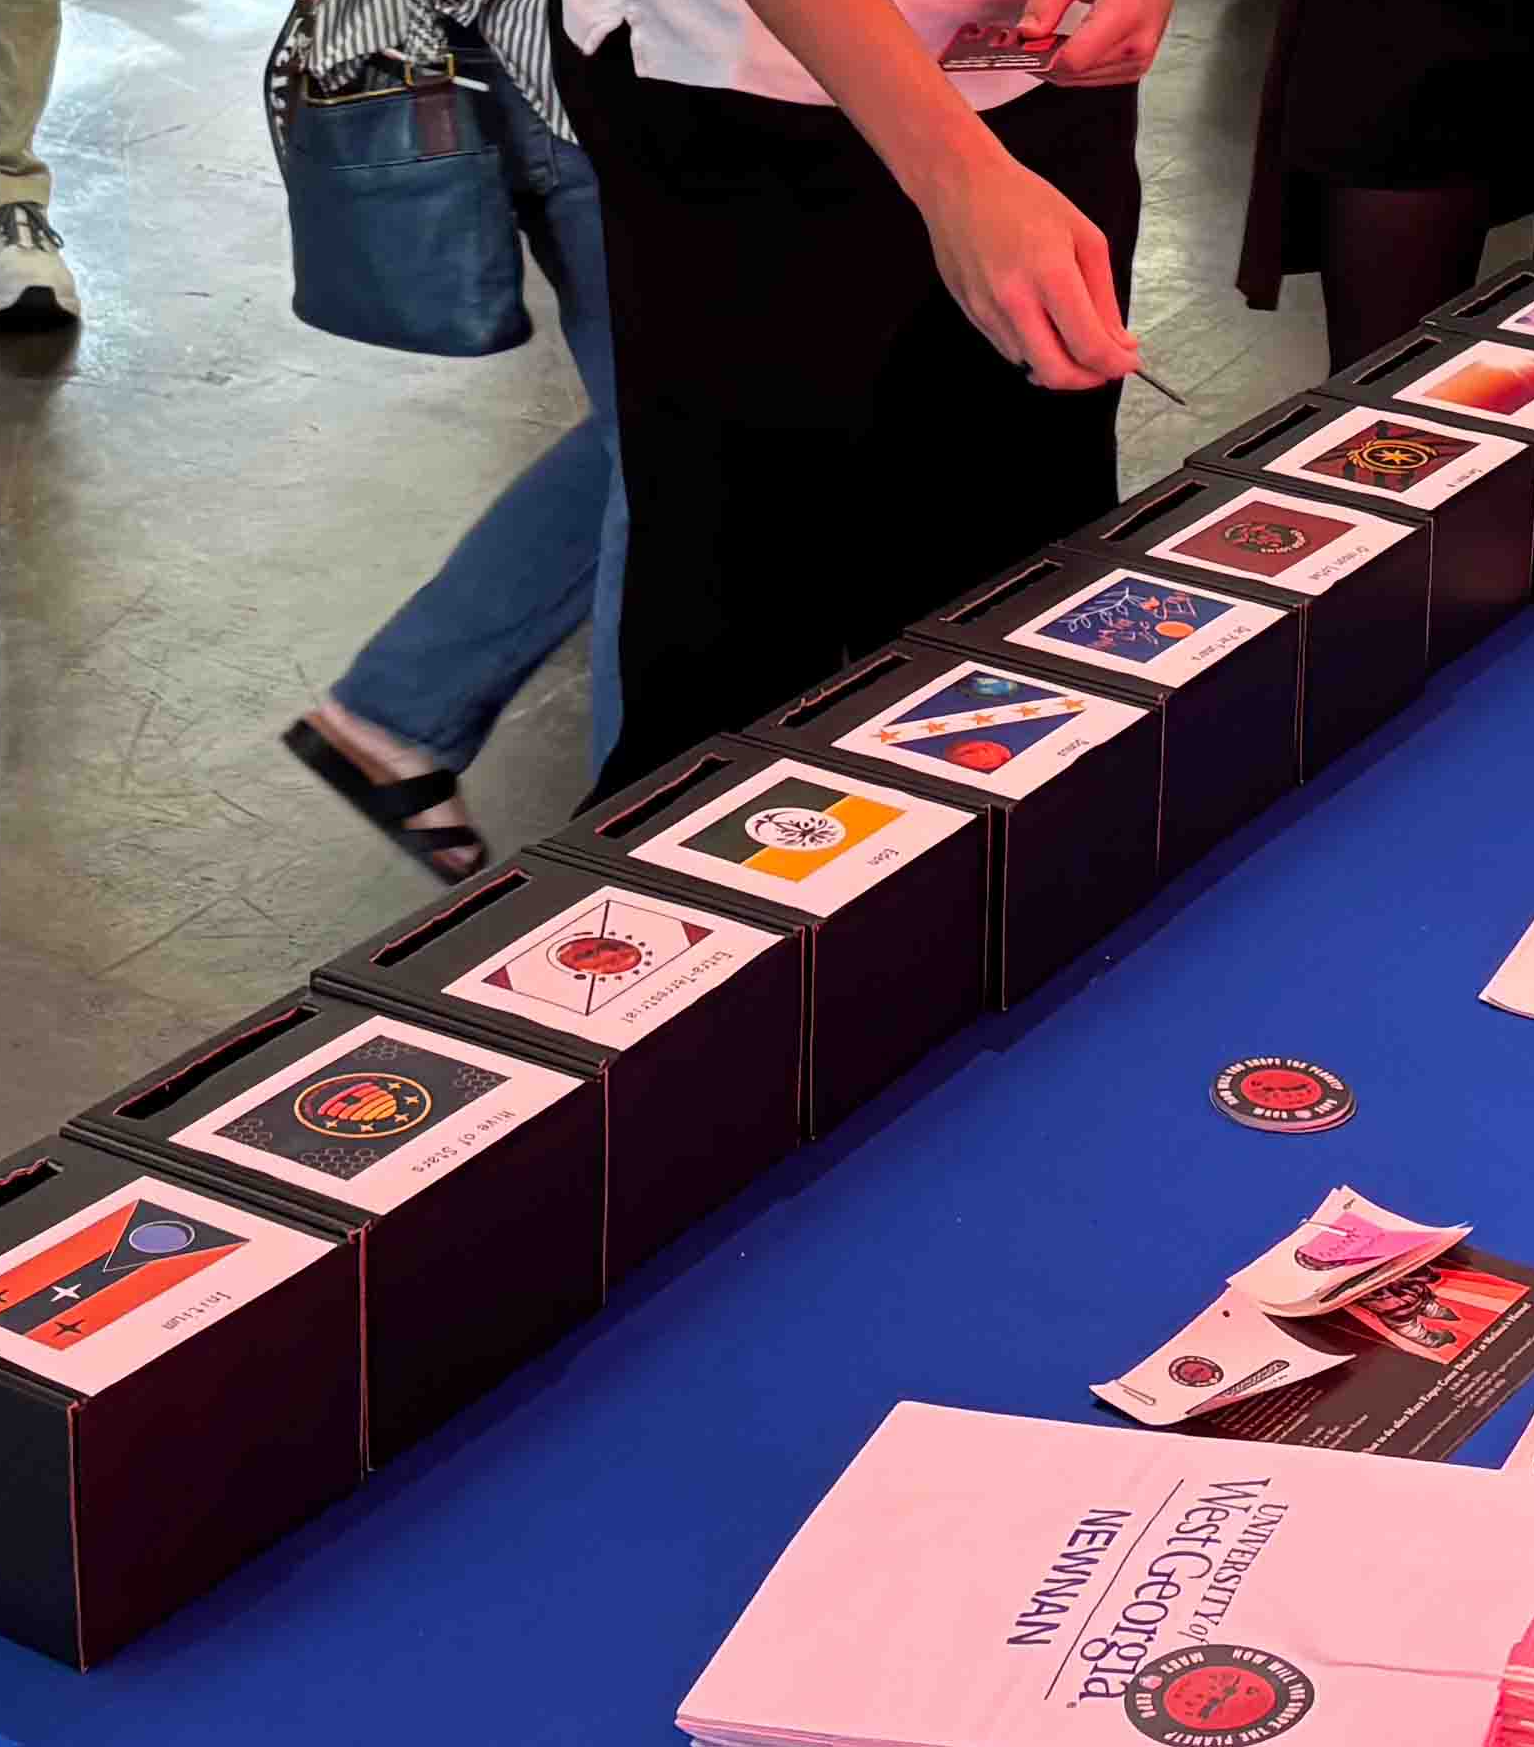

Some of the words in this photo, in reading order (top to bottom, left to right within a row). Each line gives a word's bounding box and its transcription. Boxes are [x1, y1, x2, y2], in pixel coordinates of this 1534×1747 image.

[620, 951, 733, 1024] Extra-Terrestrial
[457, 1132, 476, 1146] of
[477, 1110, 516, 1132] Hive
[411, 1145, 458, 1172] Stars
[161, 1291, 231, 1330] Initium
[1166, 1478, 1271, 1548] West
[1006, 1509, 1132, 1645] NEWNAN
[1192, 1503, 1289, 1626] UNIVERSITY
[1079, 1551, 1213, 1702] Georgia
[1177, 1622, 1210, 1646] of
[1160, 1651, 1205, 1675] MARS
[1232, 1649, 1268, 1665] HOW
[1267, 1661, 1298, 1684] WILL
